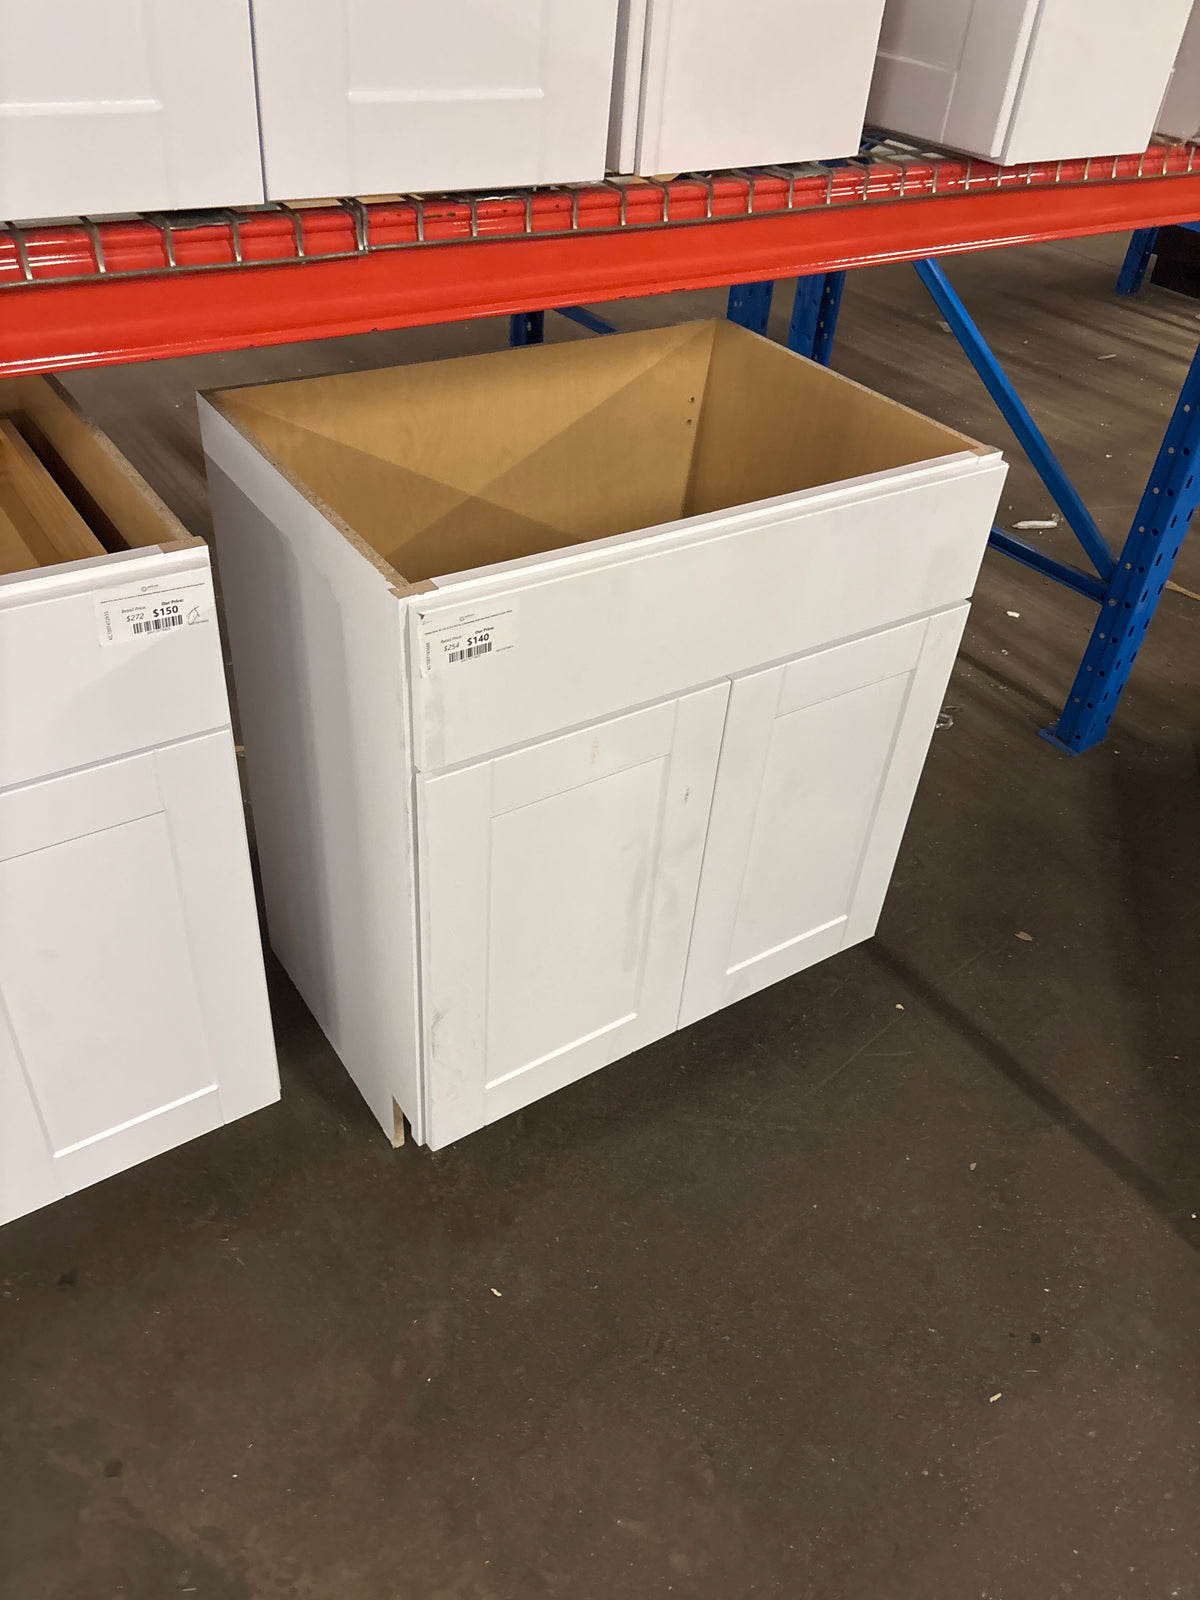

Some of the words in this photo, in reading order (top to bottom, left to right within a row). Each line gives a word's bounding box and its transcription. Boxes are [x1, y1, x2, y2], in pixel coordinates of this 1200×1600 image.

[126, 612, 145, 623] $272
[152, 605, 179, 618] $150
[467, 633, 489, 646] $140
[443, 642, 460, 652] $254
